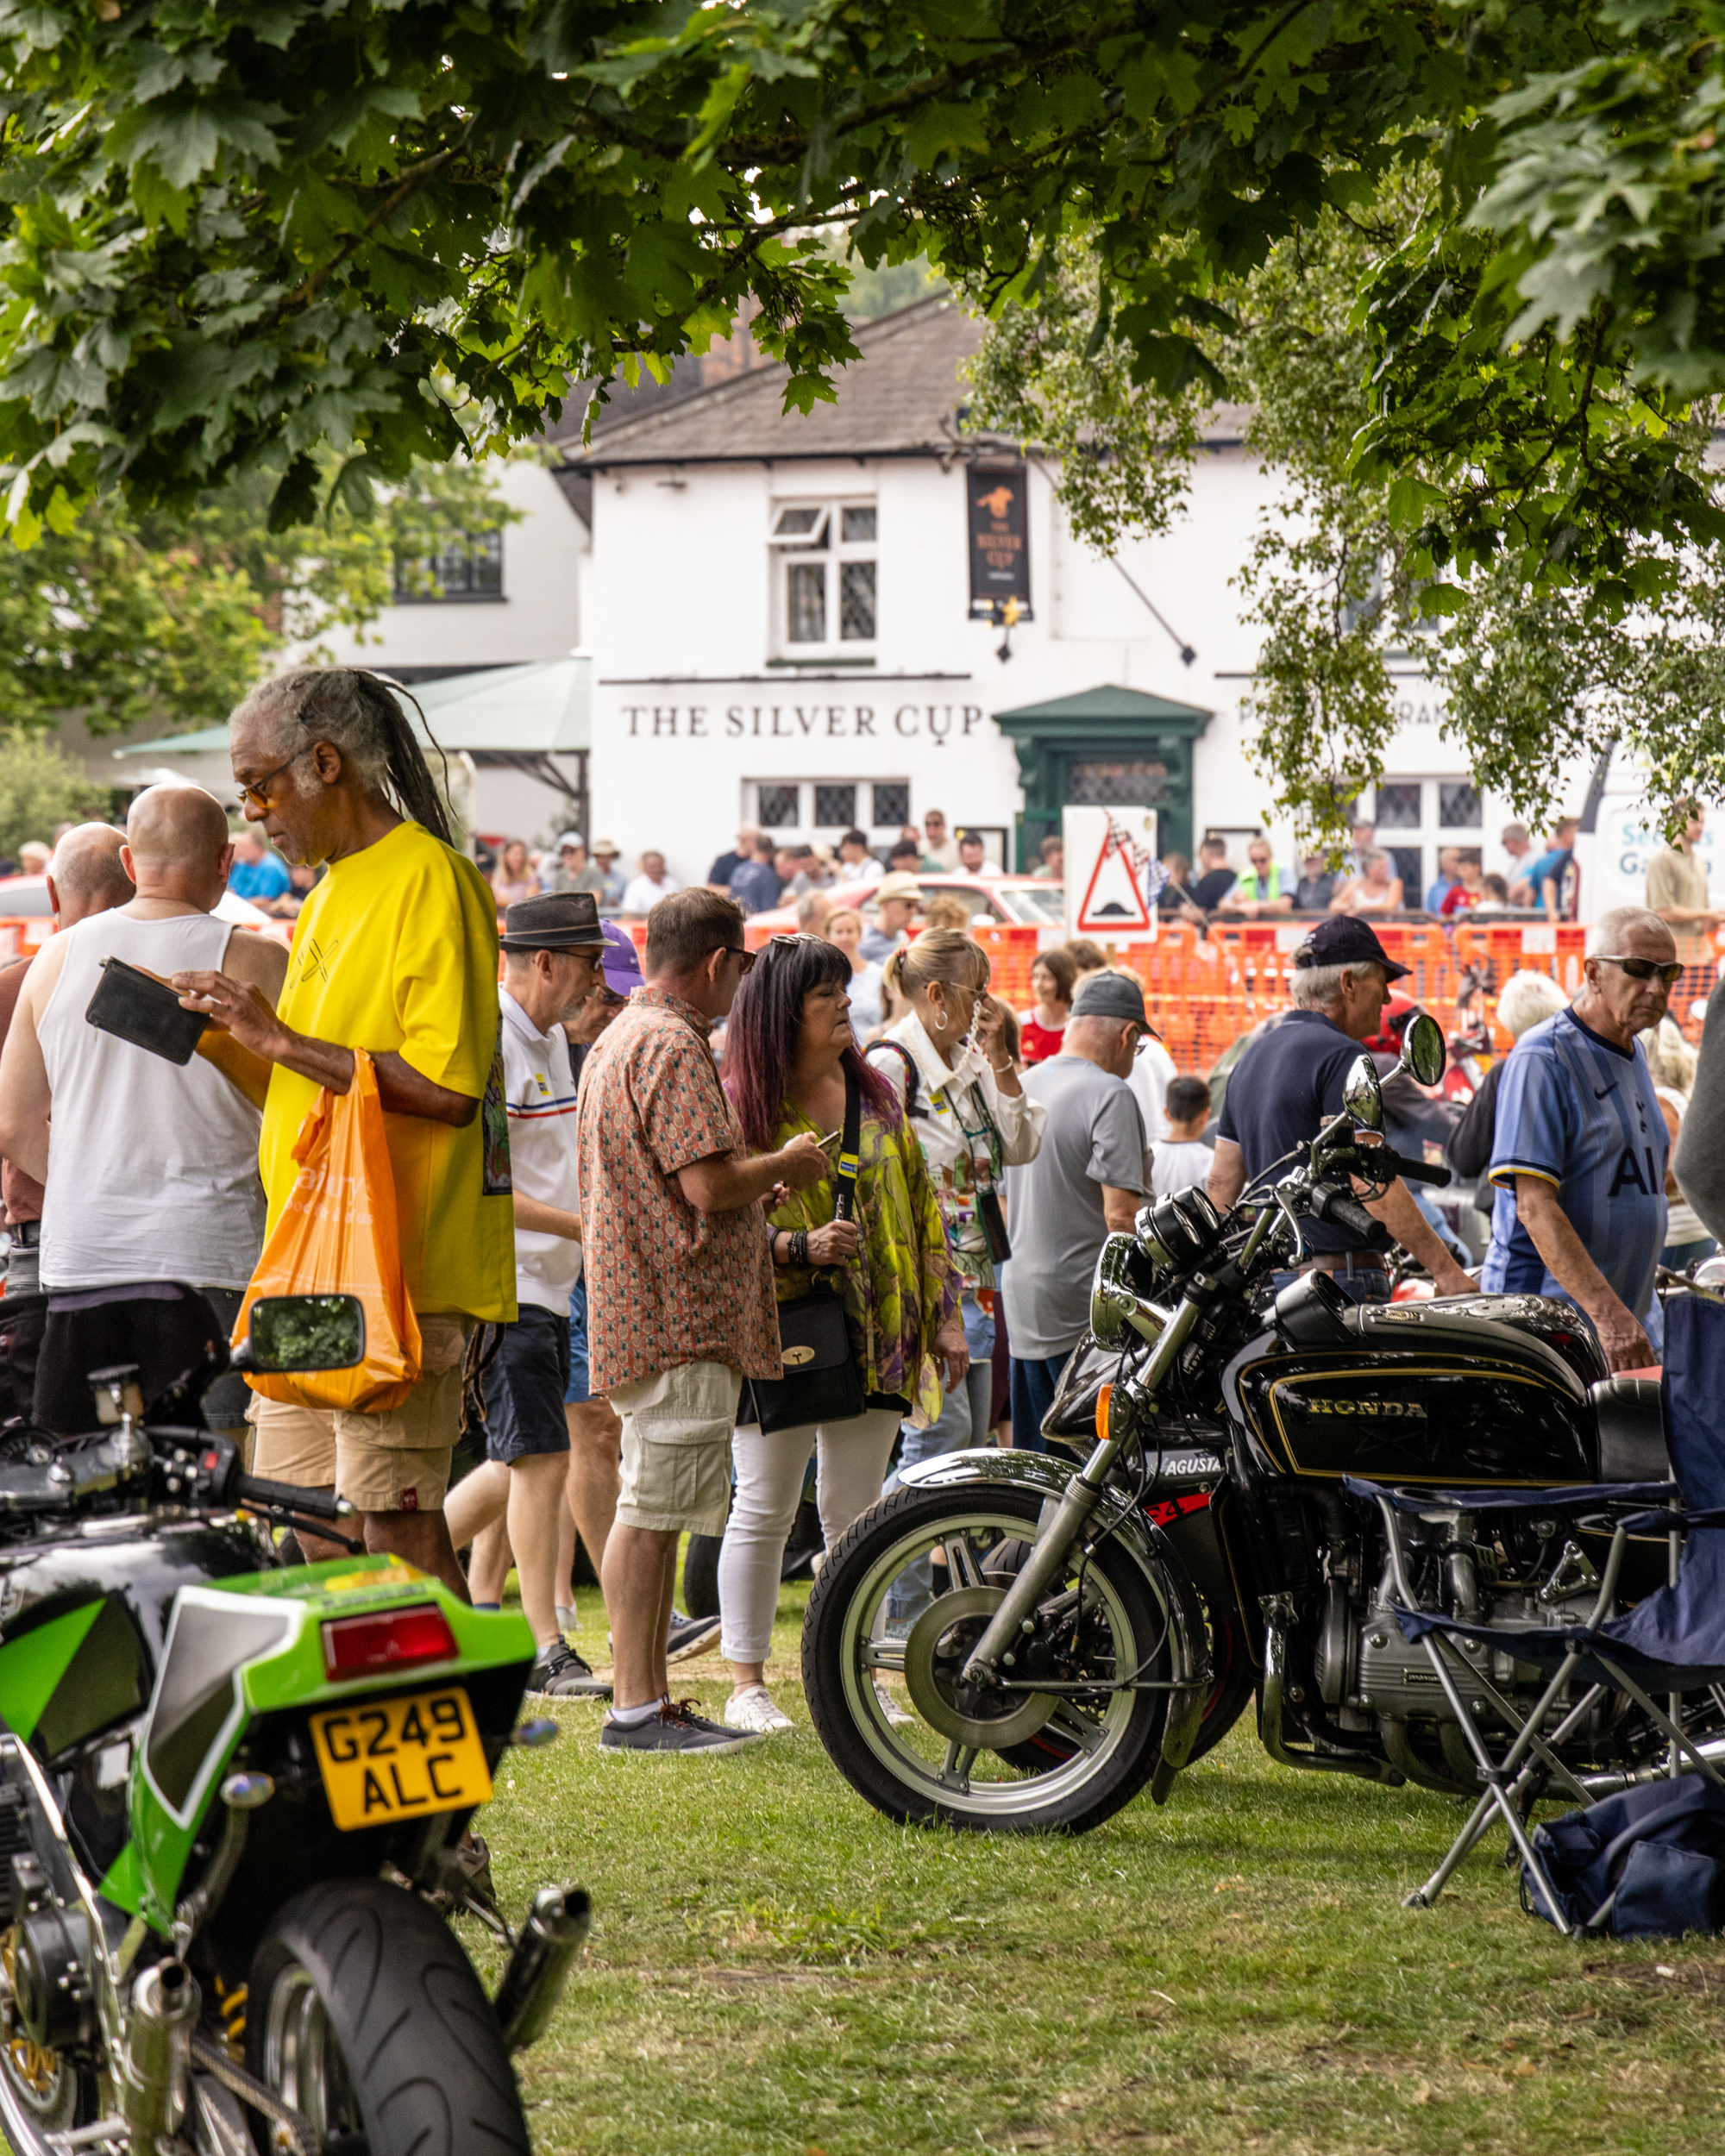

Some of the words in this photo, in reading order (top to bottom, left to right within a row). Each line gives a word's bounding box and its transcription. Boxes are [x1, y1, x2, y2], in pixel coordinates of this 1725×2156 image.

[622, 706, 708, 736] THE
[726, 705, 877, 736] SILVER
[894, 705, 983, 745] CUP
[1308, 1397, 1428, 1419] HONDA
[323, 1697, 466, 1762] G249
[363, 1754, 463, 1815] ALC
